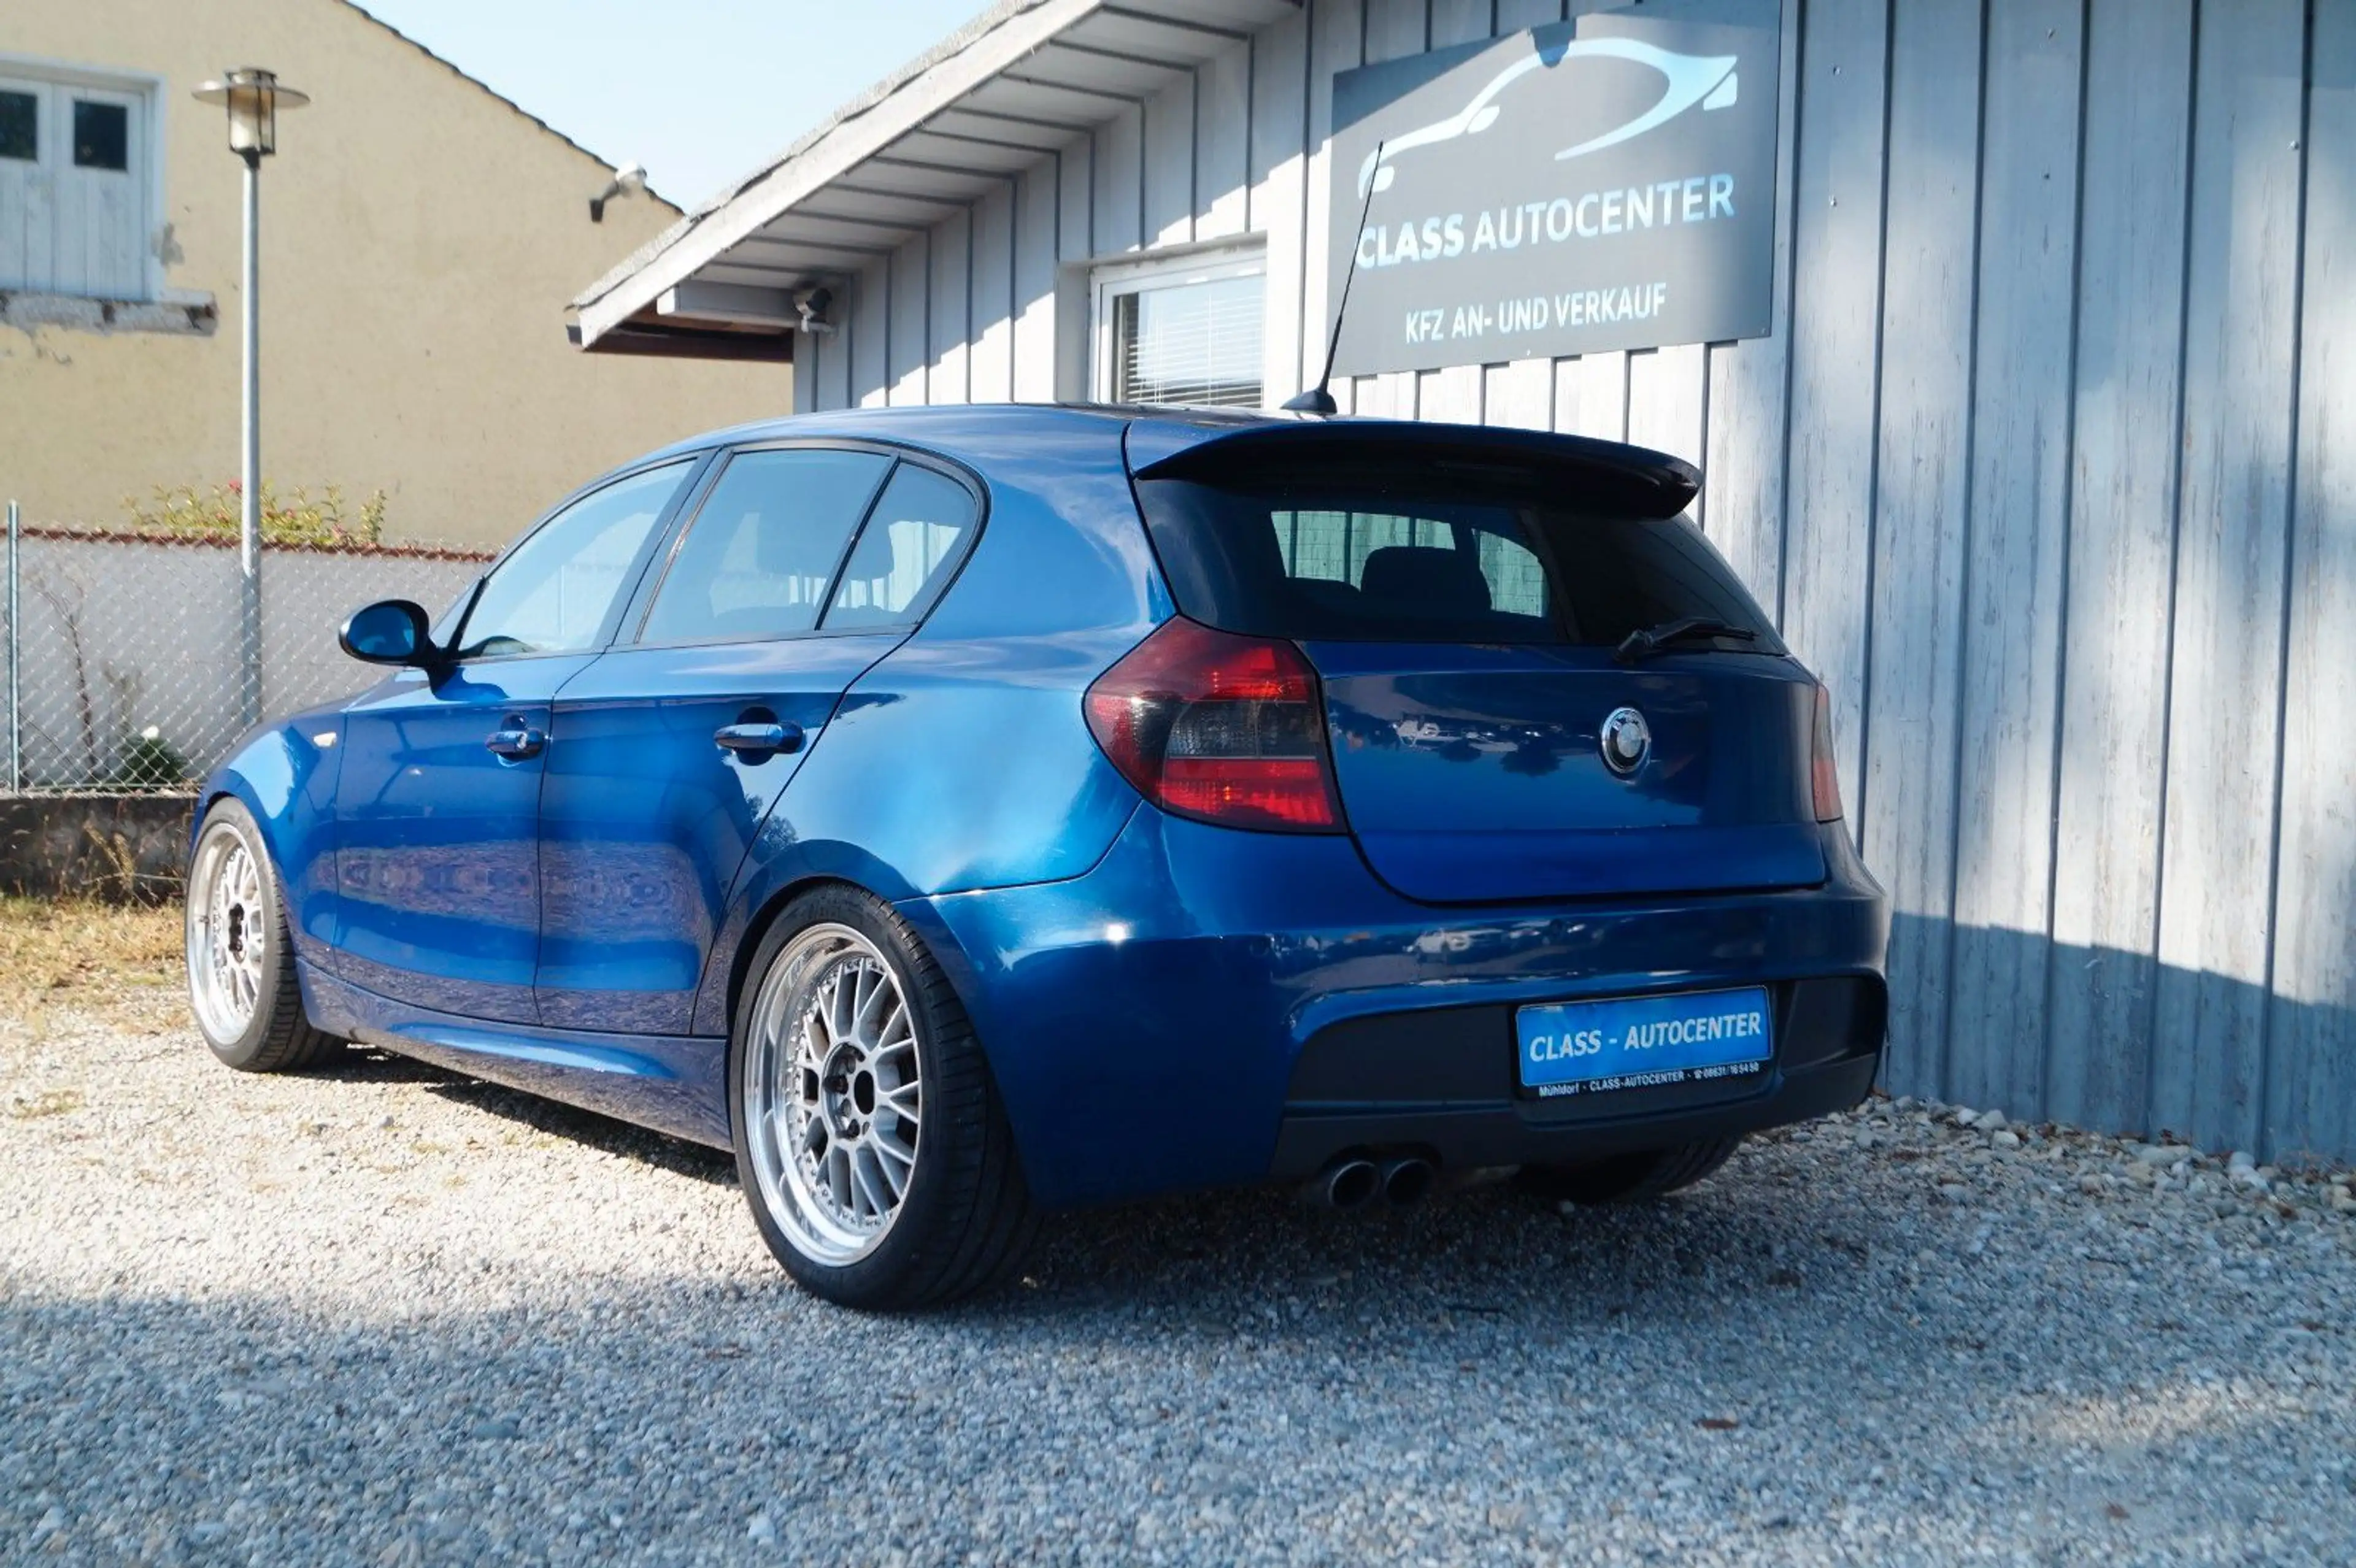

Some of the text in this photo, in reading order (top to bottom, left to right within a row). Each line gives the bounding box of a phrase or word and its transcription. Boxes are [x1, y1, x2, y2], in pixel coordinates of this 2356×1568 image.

[1355, 173, 1736, 269] CLASS AUTOCENTER
[1406, 282, 1667, 344] KFZ AN- UND VERKAUF
[1529, 1029, 1602, 1063] CLASS
[1623, 1012, 1761, 1051] AUTOCENTER
